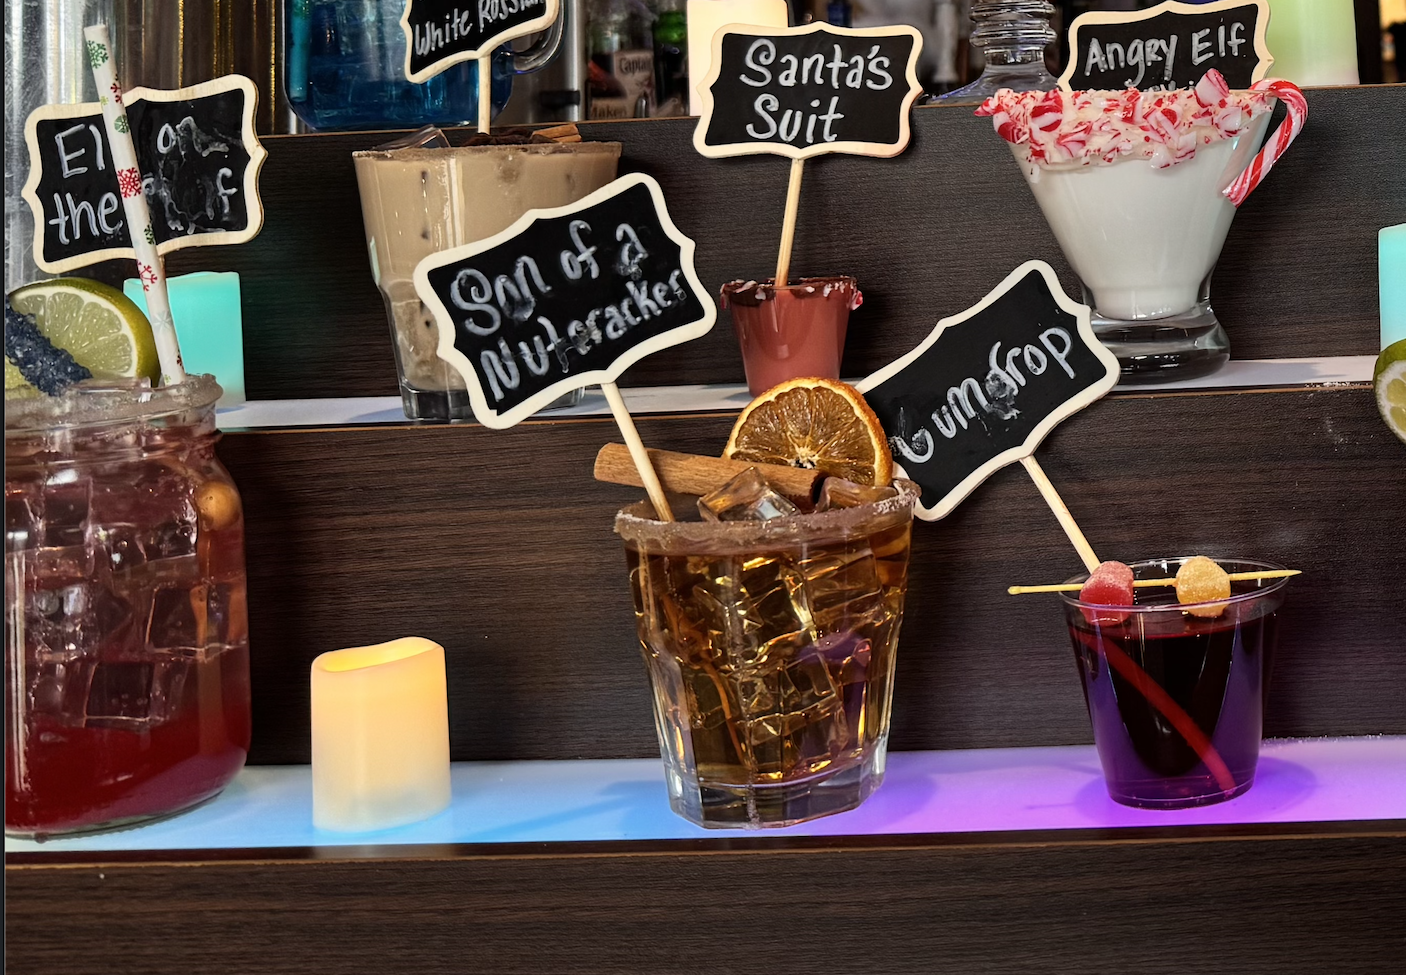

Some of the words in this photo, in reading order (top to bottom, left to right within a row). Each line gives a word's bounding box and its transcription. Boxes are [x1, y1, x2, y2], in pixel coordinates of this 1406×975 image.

[415, 8, 473, 56] White
[1084, 34, 1178, 88] Angry
[1191, 22, 1246, 66] Elf
[739, 38, 893, 90] Santa's
[746, 93, 845, 144] Suit
[54, 123, 106, 178] El
[49, 191, 124, 245] the
[450, 255, 552, 336] Son
[560, 220, 599, 280] of
[615, 223, 649, 279] a
